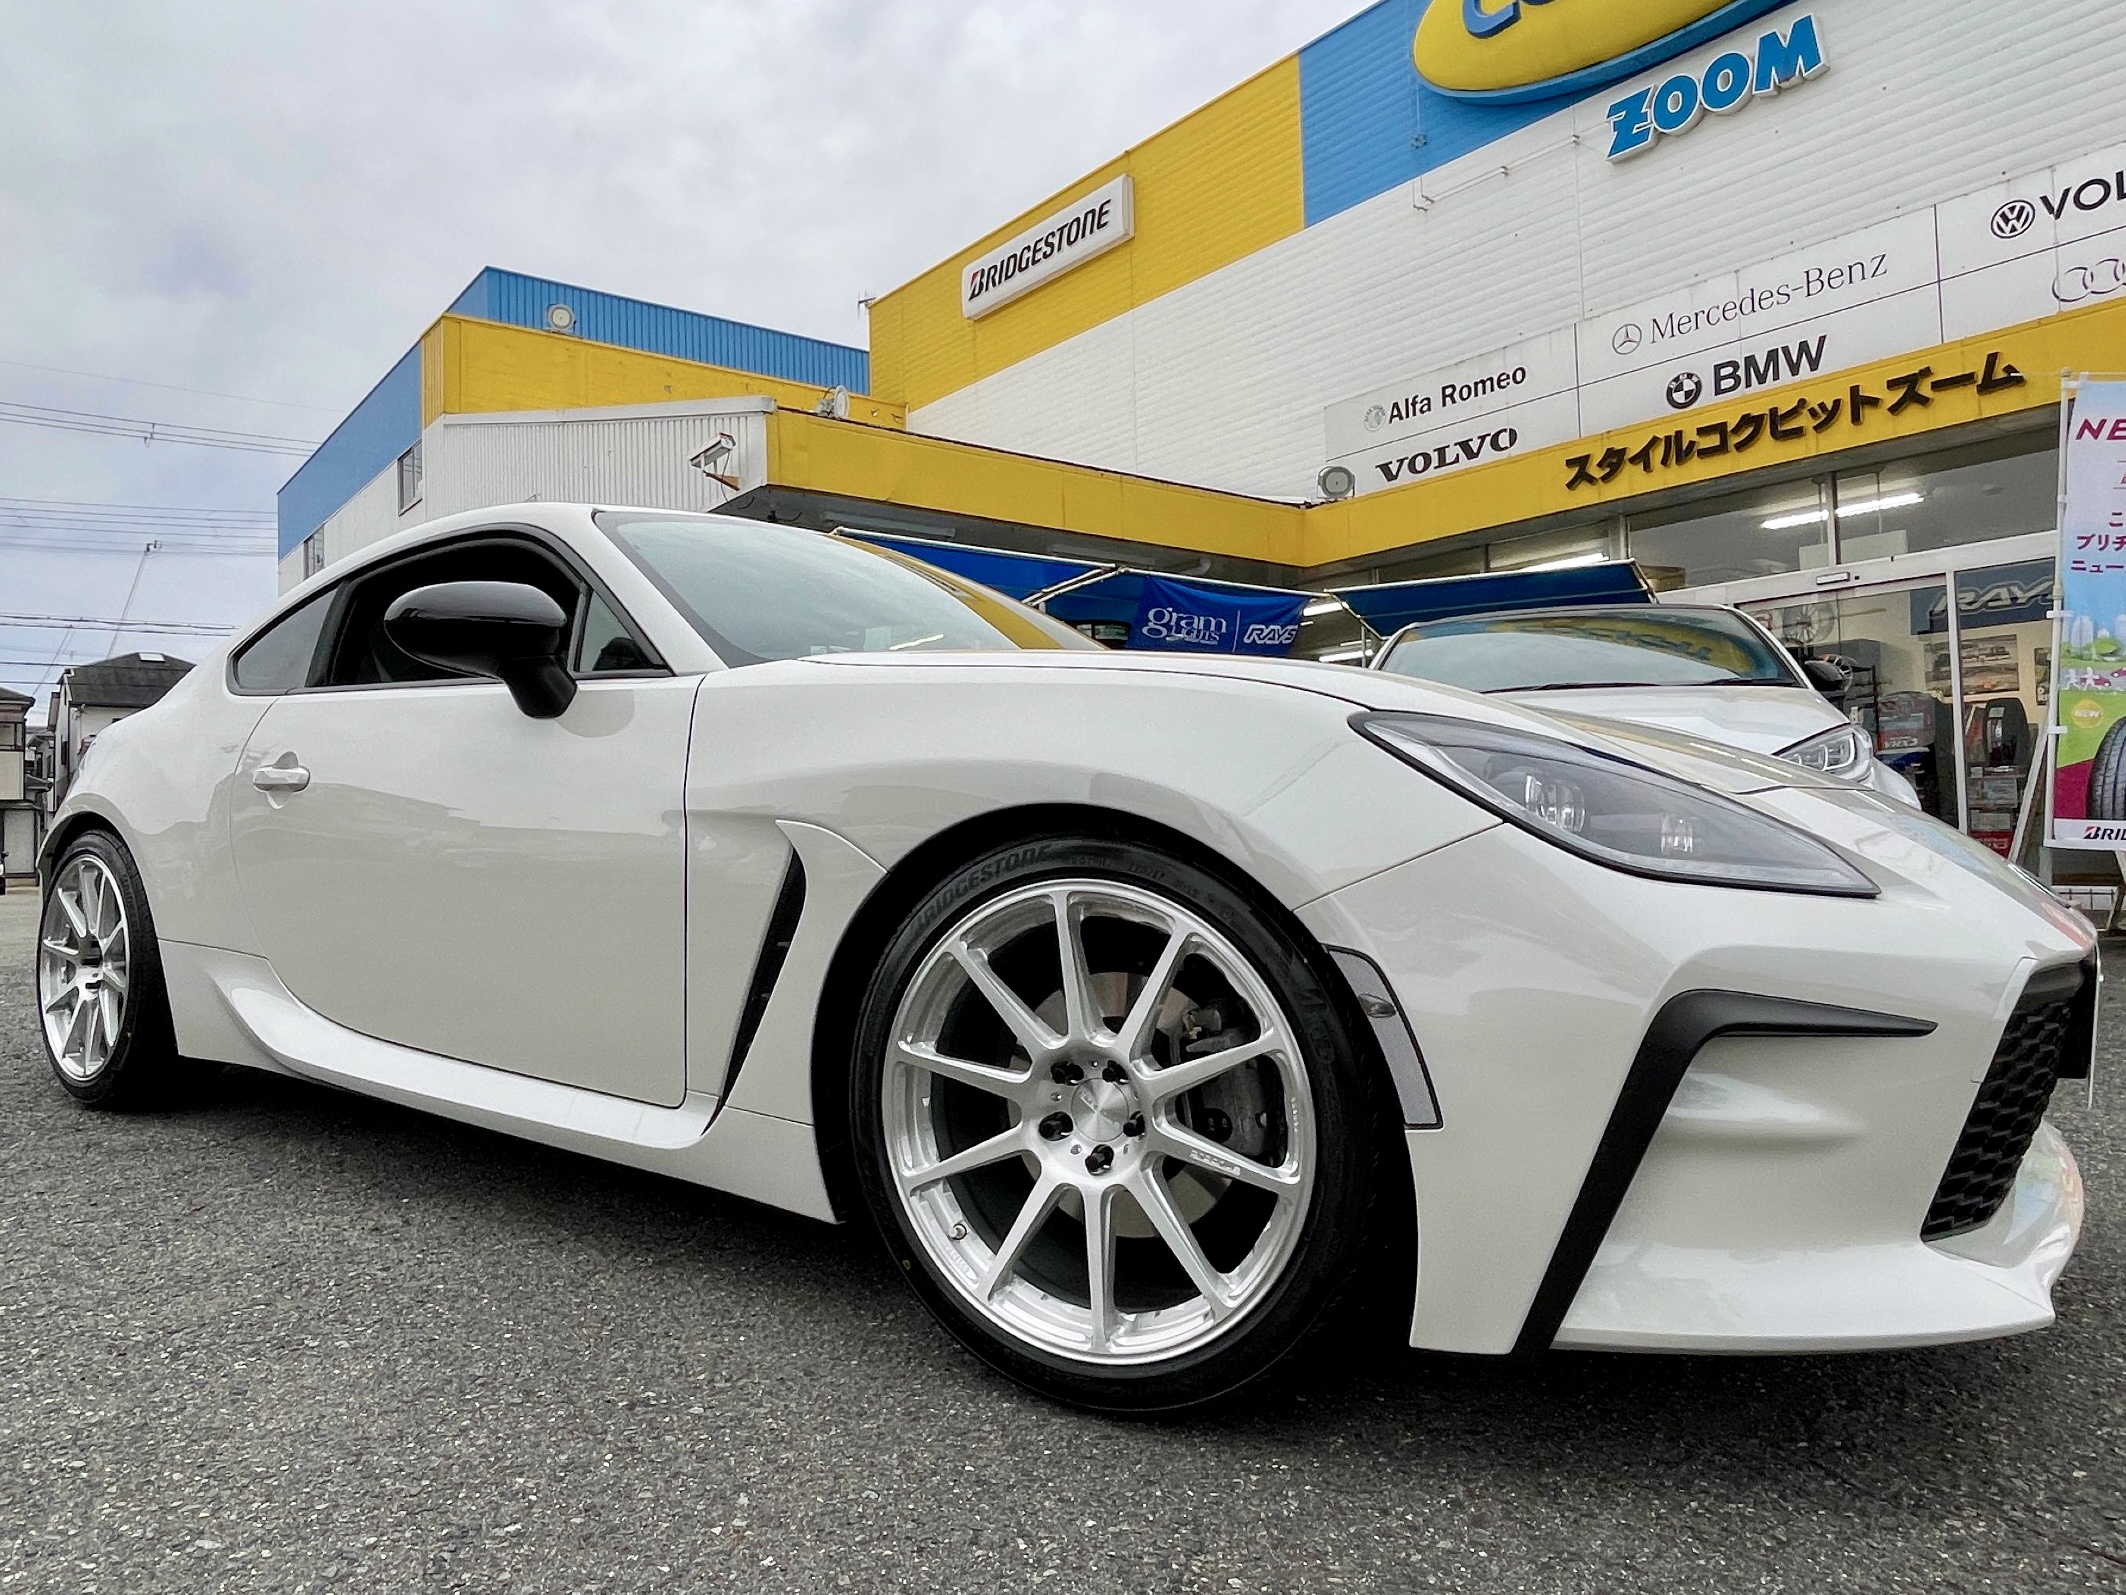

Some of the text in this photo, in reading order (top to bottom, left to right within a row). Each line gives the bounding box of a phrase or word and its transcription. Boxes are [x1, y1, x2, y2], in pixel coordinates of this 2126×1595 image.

[1605, 13, 1824, 160] ZOOM
[968, 199, 1111, 301] BRIDGESTONE
[1650, 253, 1888, 344] Mercedes-Benz
[1388, 395, 1432, 424] Alfa
[1441, 366, 1526, 407] Romeo
[1713, 334, 1827, 396] BMW
[1565, 352, 2026, 491] スタイルコクピットズーム
[1375, 428, 1518, 482] VOLVO
[1141, 607, 1298, 645] gram RAYS
[1929, 577, 2055, 615] RAY
